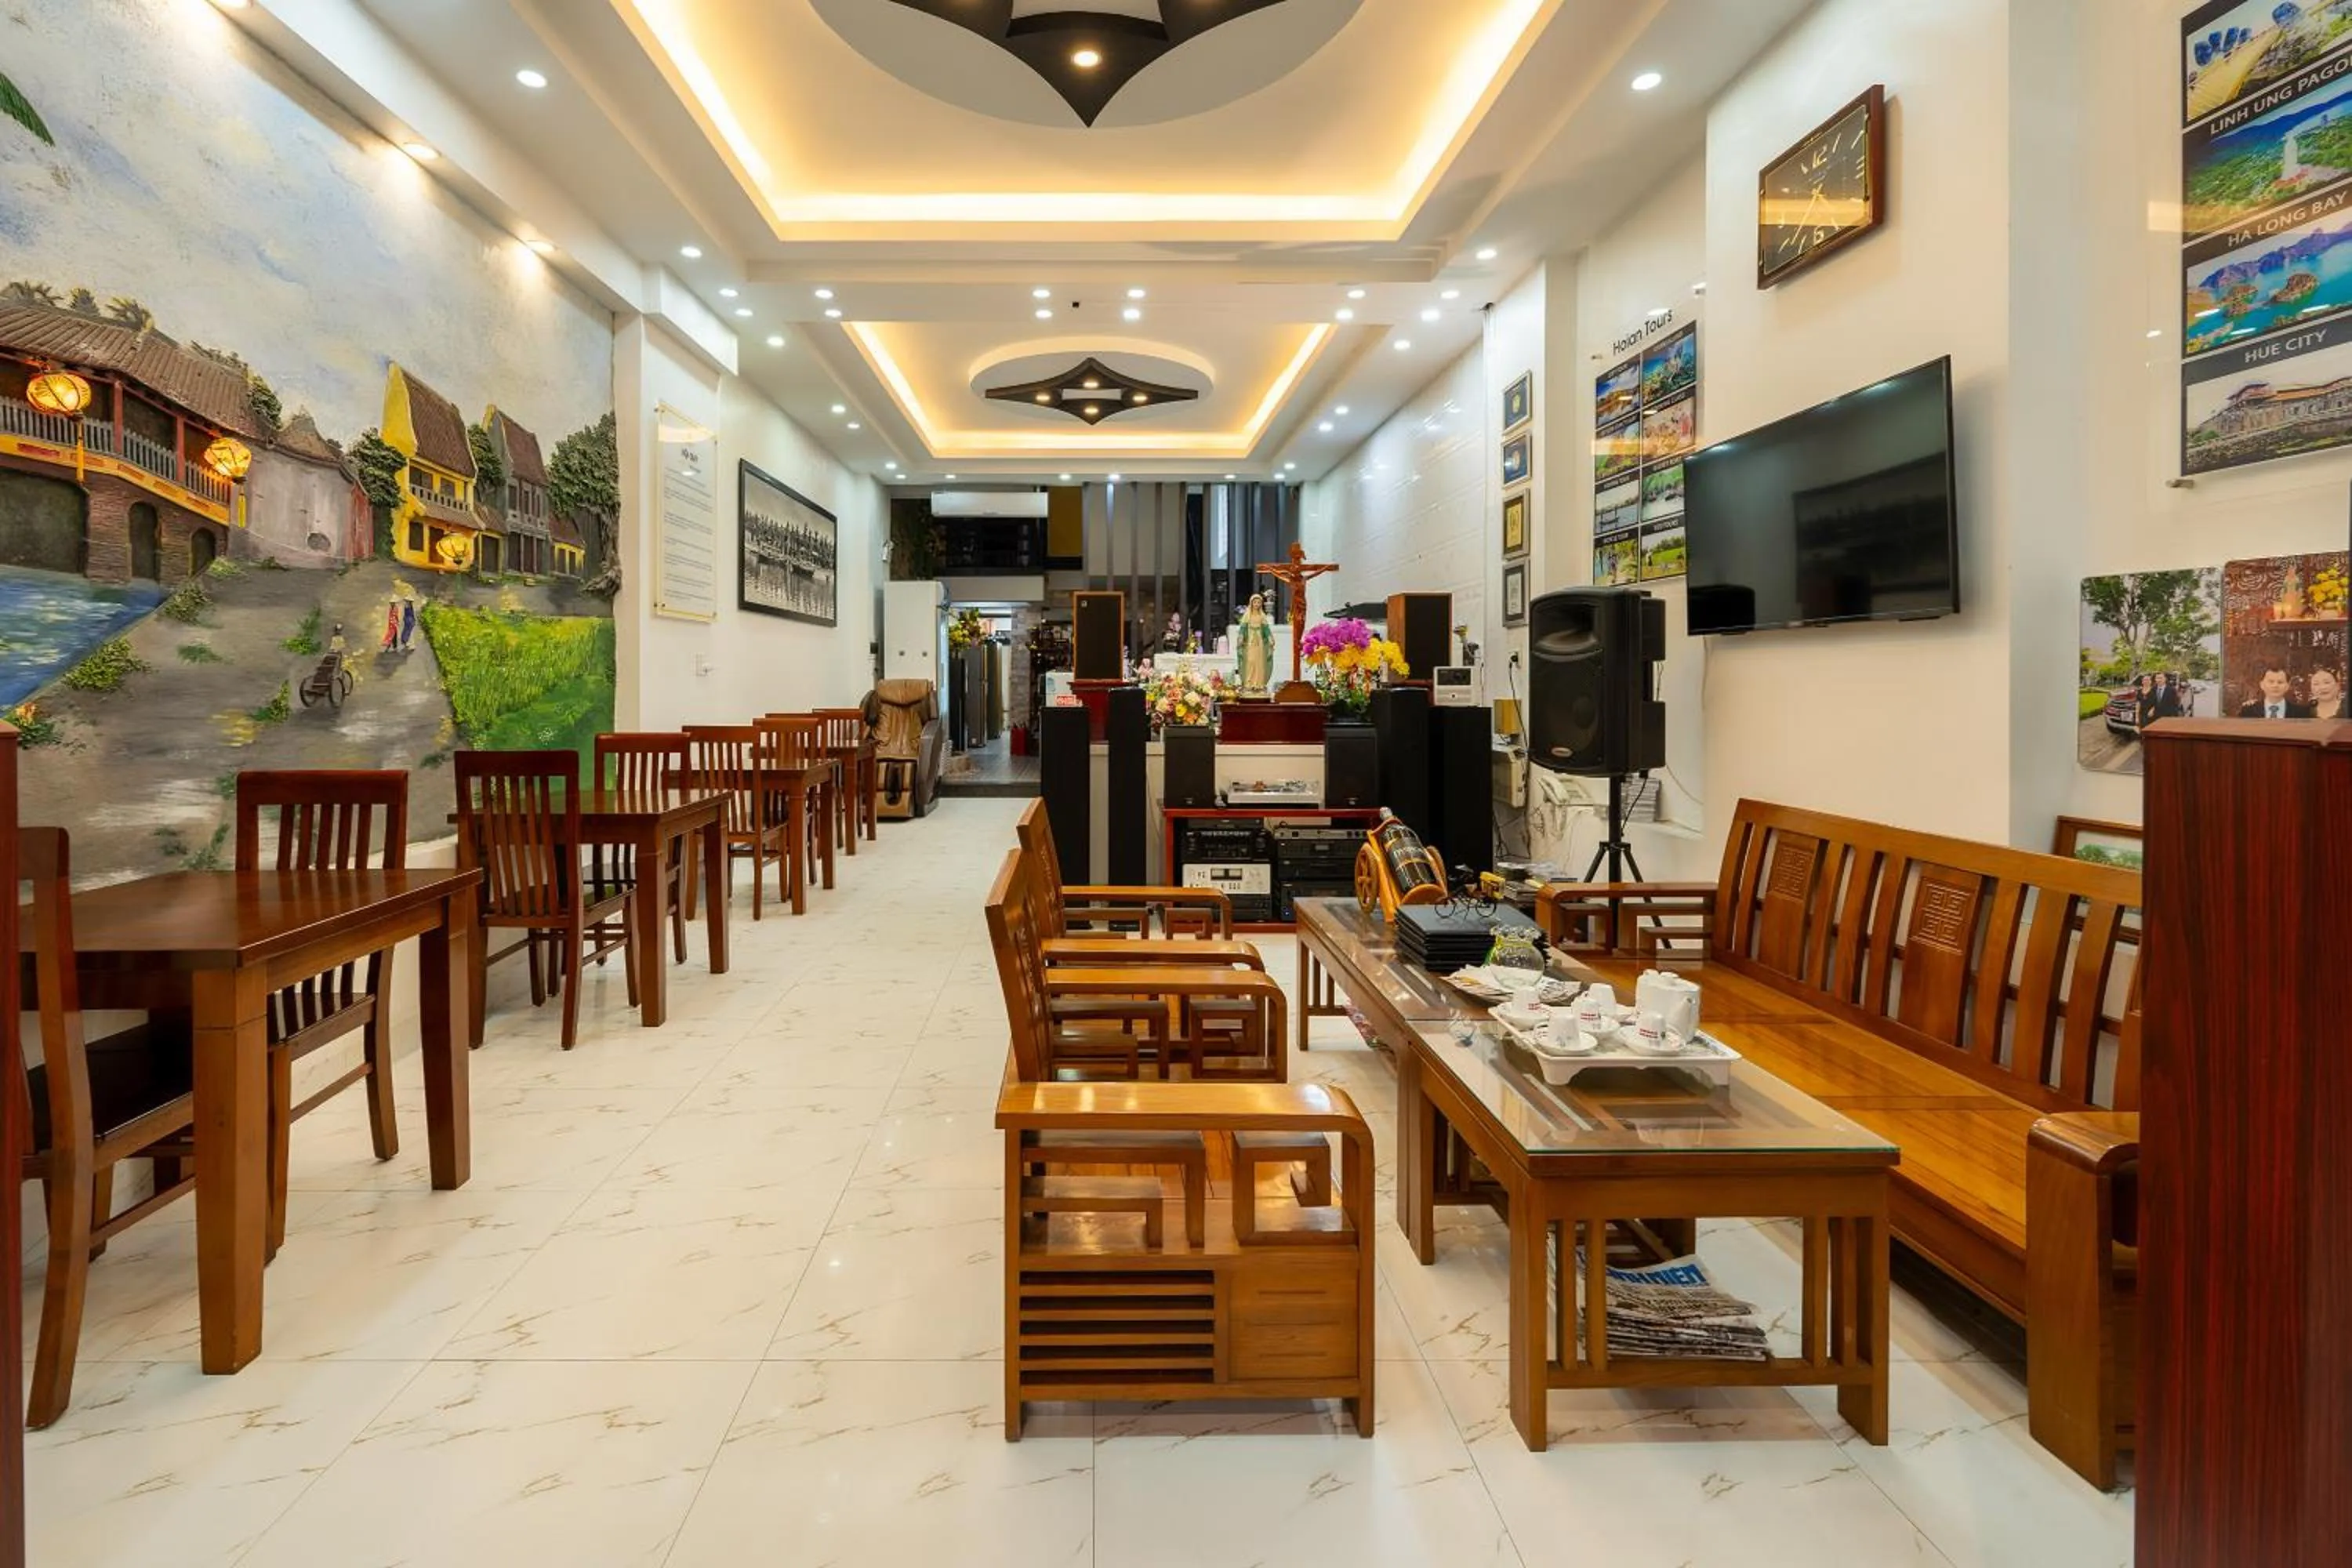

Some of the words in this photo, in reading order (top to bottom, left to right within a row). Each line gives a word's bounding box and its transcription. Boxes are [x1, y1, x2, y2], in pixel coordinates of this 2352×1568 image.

[2210, 107, 2249, 135] LINH
[2254, 85, 2293, 112] UNG
[2298, 53, 2352, 92] PAGO
[2228, 230, 2252, 247] HA
[2258, 207, 2306, 235] LONG
[2312, 190, 2348, 214] BAY
[1644, 309, 1672, 336] Tours
[2245, 343, 2281, 363] HUE
[2285, 328, 2327, 350] CITY
